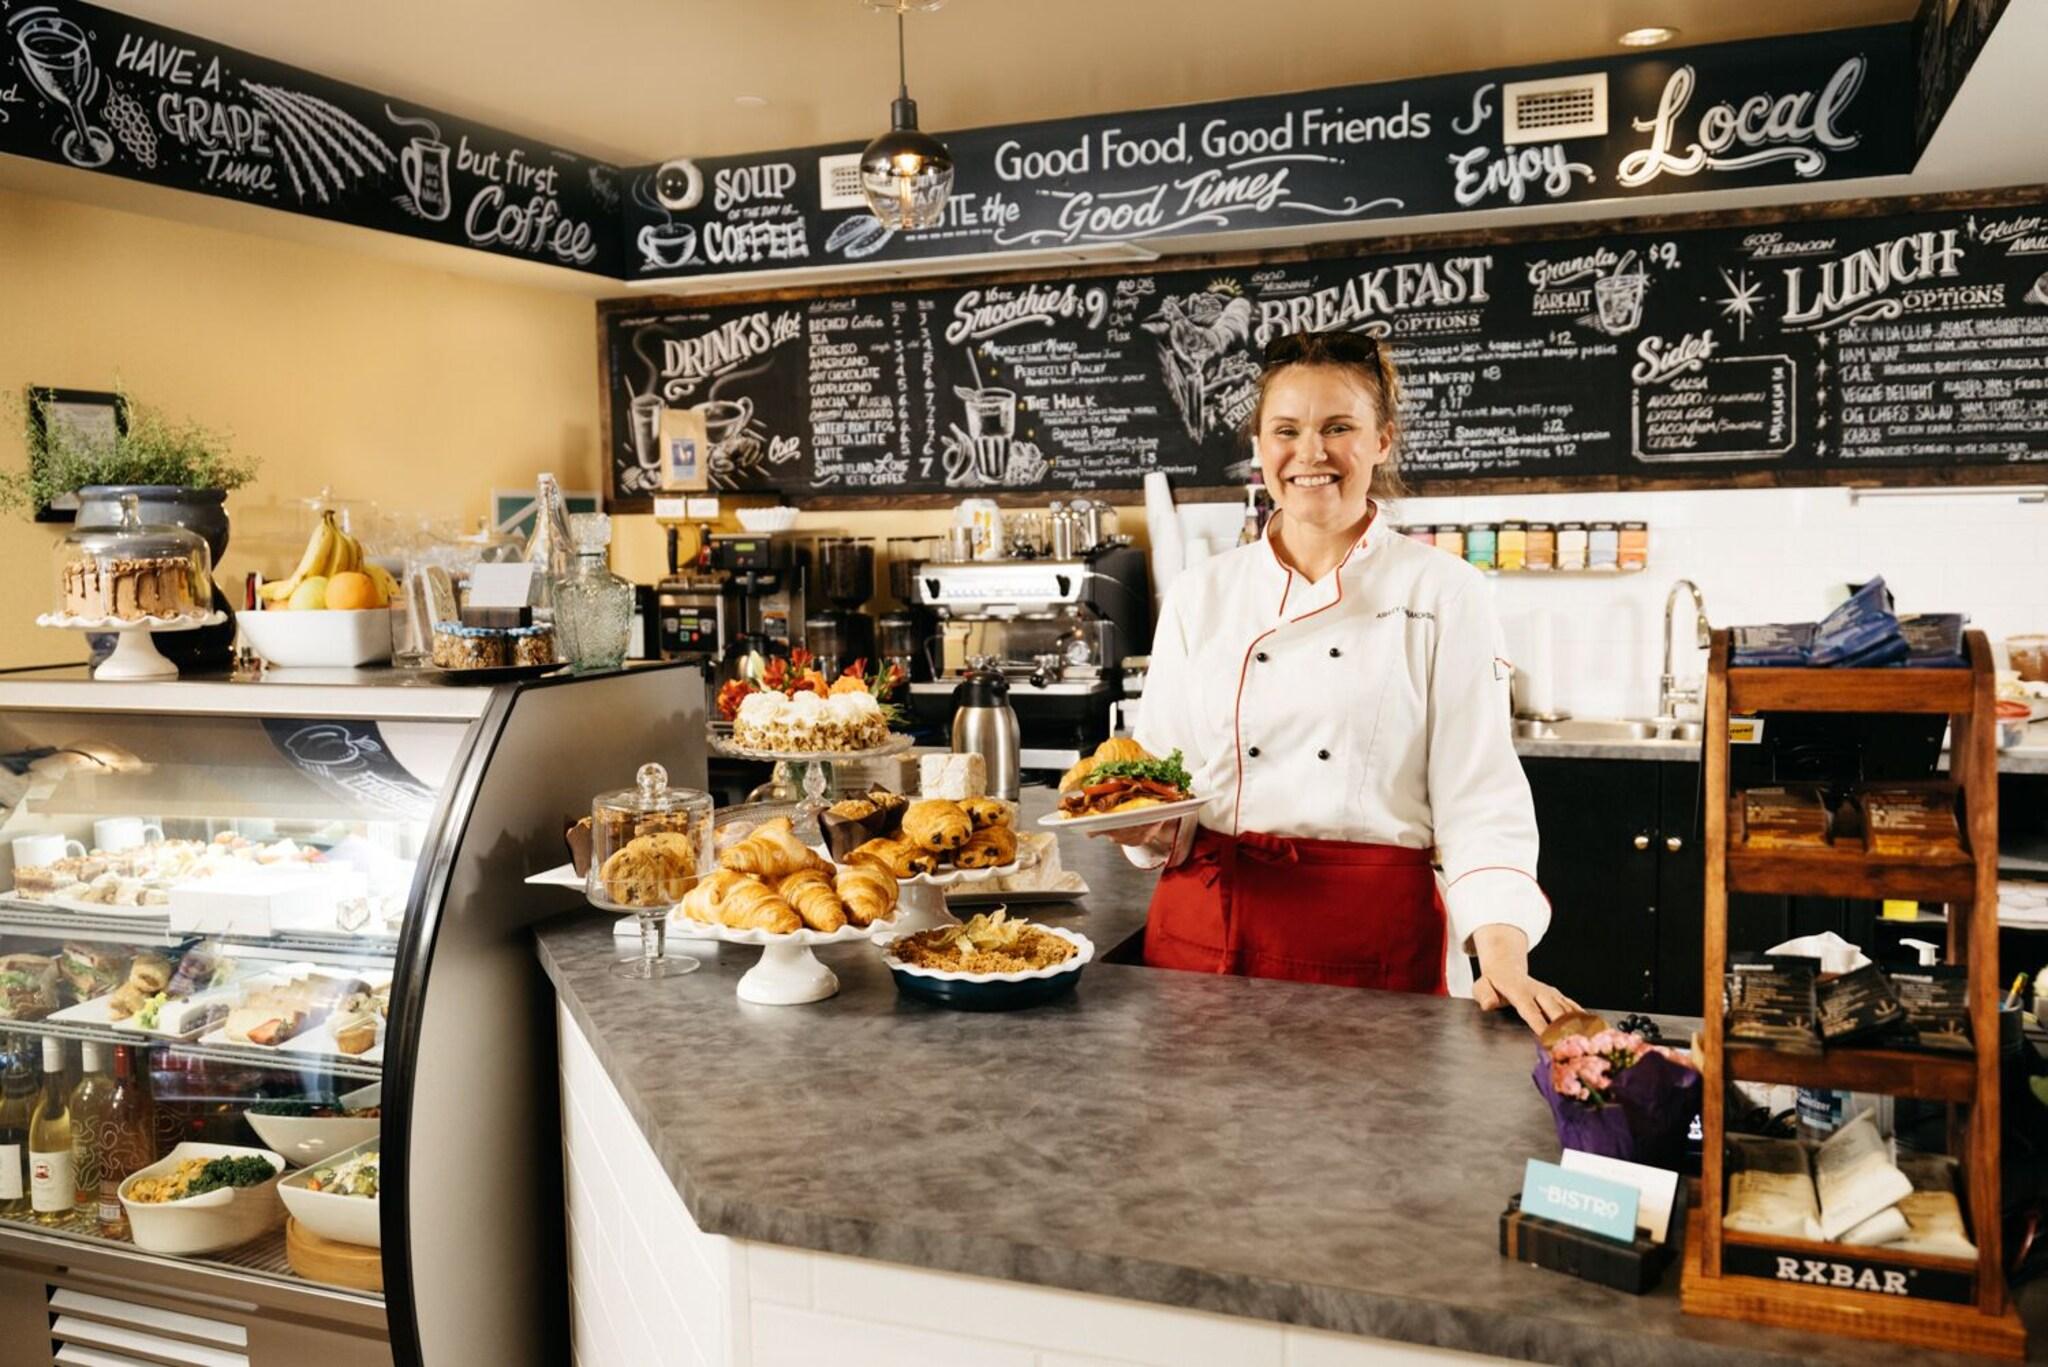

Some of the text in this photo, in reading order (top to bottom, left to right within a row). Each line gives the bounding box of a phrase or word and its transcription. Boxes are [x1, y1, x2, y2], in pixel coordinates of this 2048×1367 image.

[116, 33, 220, 93] HAVE A
[157, 92, 273, 157] GRAPE
[1616, 53, 1866, 187] Local
[995, 100, 1432, 182] Good Food, Good Friends
[198, 148, 277, 190] Time
[456, 136, 500, 182] but
[505, 148, 559, 196] first
[1448, 143, 1595, 205] Enjoy
[714, 162, 797, 212] SOUP
[981, 192, 1021, 224] the
[1059, 167, 1291, 243] Good Times
[464, 184, 598, 265] Coffee
[703, 216, 810, 264] COFFEE
[1743, 232, 1783, 248] GOOD
[1752, 238, 1837, 256] AFTERNOON
[1251, 269, 1286, 282] GOOD
[1526, 247, 1619, 290] Granola
[1781, 229, 1965, 323] LUNCH
[1255, 255, 1493, 346] BREAKFAST
[1532, 288, 1592, 311] PARFAIT
[1903, 287, 2005, 309] OPTIONS
[945, 283, 1079, 346] Smoothies
[1394, 313, 1481, 331] OPTIONS
[661, 311, 771, 378] DRINKS
[810, 333, 829, 345] TEA
[1838, 327, 1869, 345] BACK
[1870, 326, 1885, 342] IN
[1632, 329, 1719, 384] Sides
[1014, 363, 1067, 380] PERFECTLY
[1428, 370, 1476, 385] MUFFIN
[1670, 376, 1708, 391] SALSA
[1023, 393, 1098, 412] THE HULK
[1647, 392, 1702, 408] AVOCADO
[1842, 384, 1884, 404] VEGGIE
[1886, 379, 1936, 402] DELIGHT
[1646, 406, 1714, 423] EXTRA EGG
[1914, 403, 1954, 422] SALAD
[835, 434, 854, 446] TEA
[854, 432, 887, 446] LATTE
[1455, 425, 1517, 440] SANDWICH
[1647, 434, 1698, 449] CEREAL
[815, 446, 844, 461] LATTE
[1415, 447, 1461, 462] WHIPPED
[1776, 1256, 1908, 1295] RXBAR
